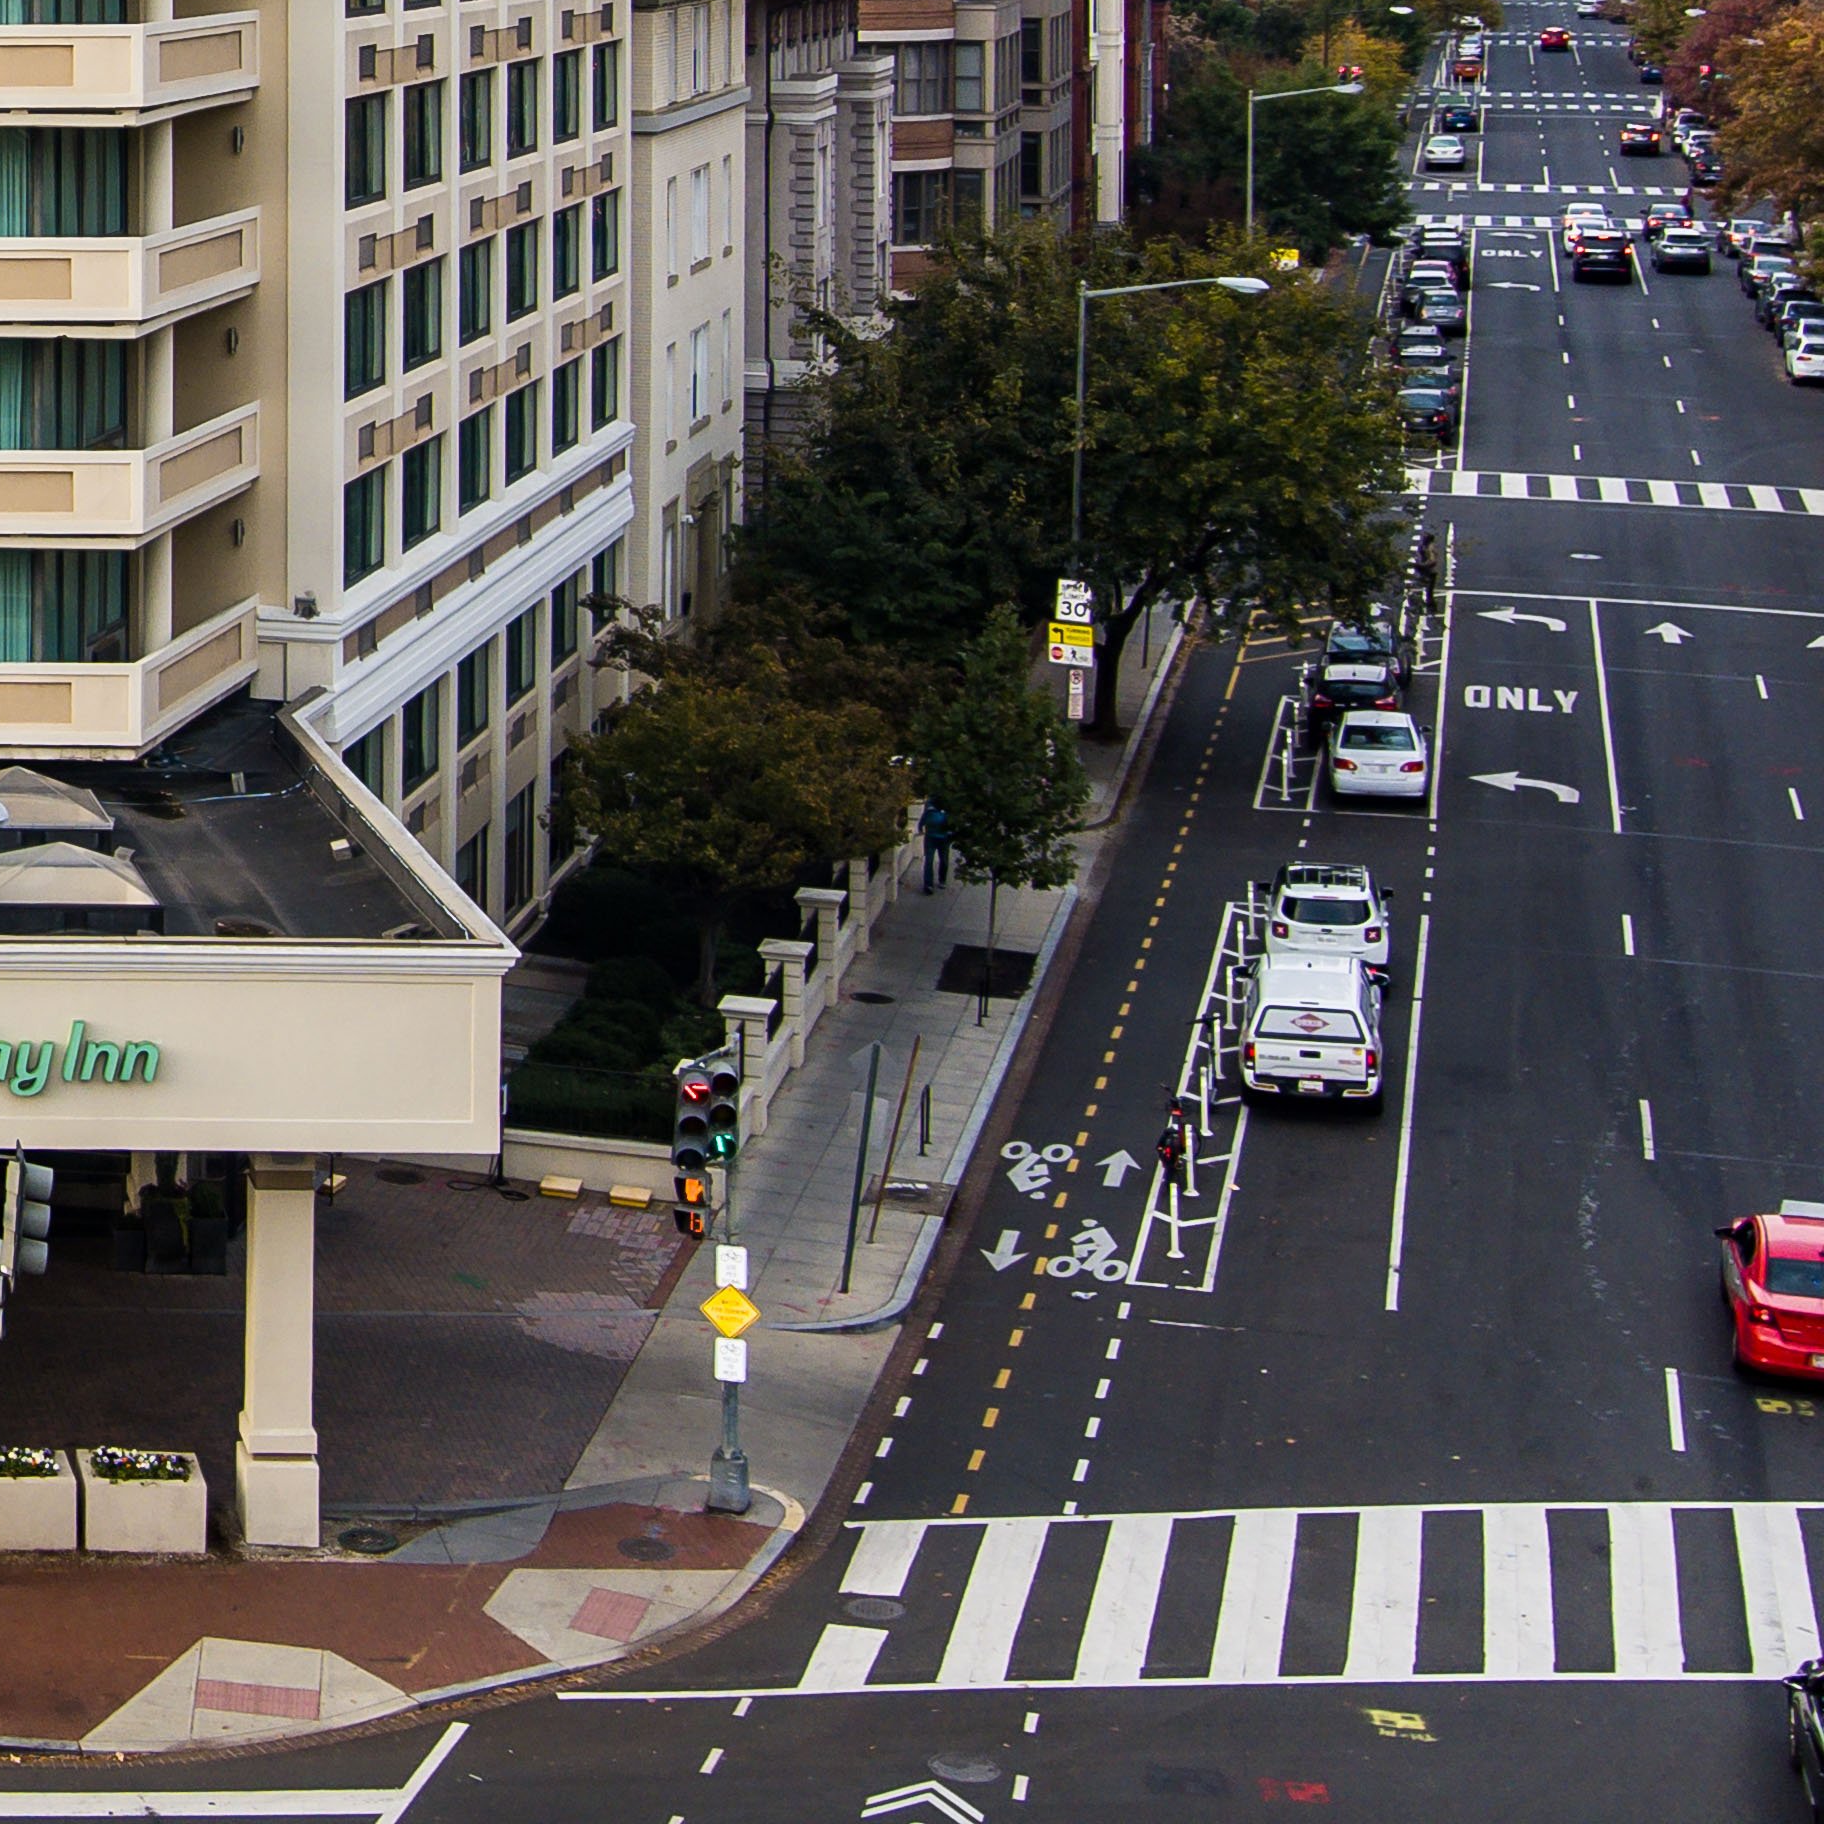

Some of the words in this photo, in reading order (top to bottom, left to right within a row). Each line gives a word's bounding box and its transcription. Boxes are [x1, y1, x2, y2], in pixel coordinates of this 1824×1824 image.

[1481, 249, 1543, 258] ONLY
[1060, 600, 1088, 617] 30
[1464, 685, 1579, 714] ONLY
[61, 1019, 160, 1083] Inn
